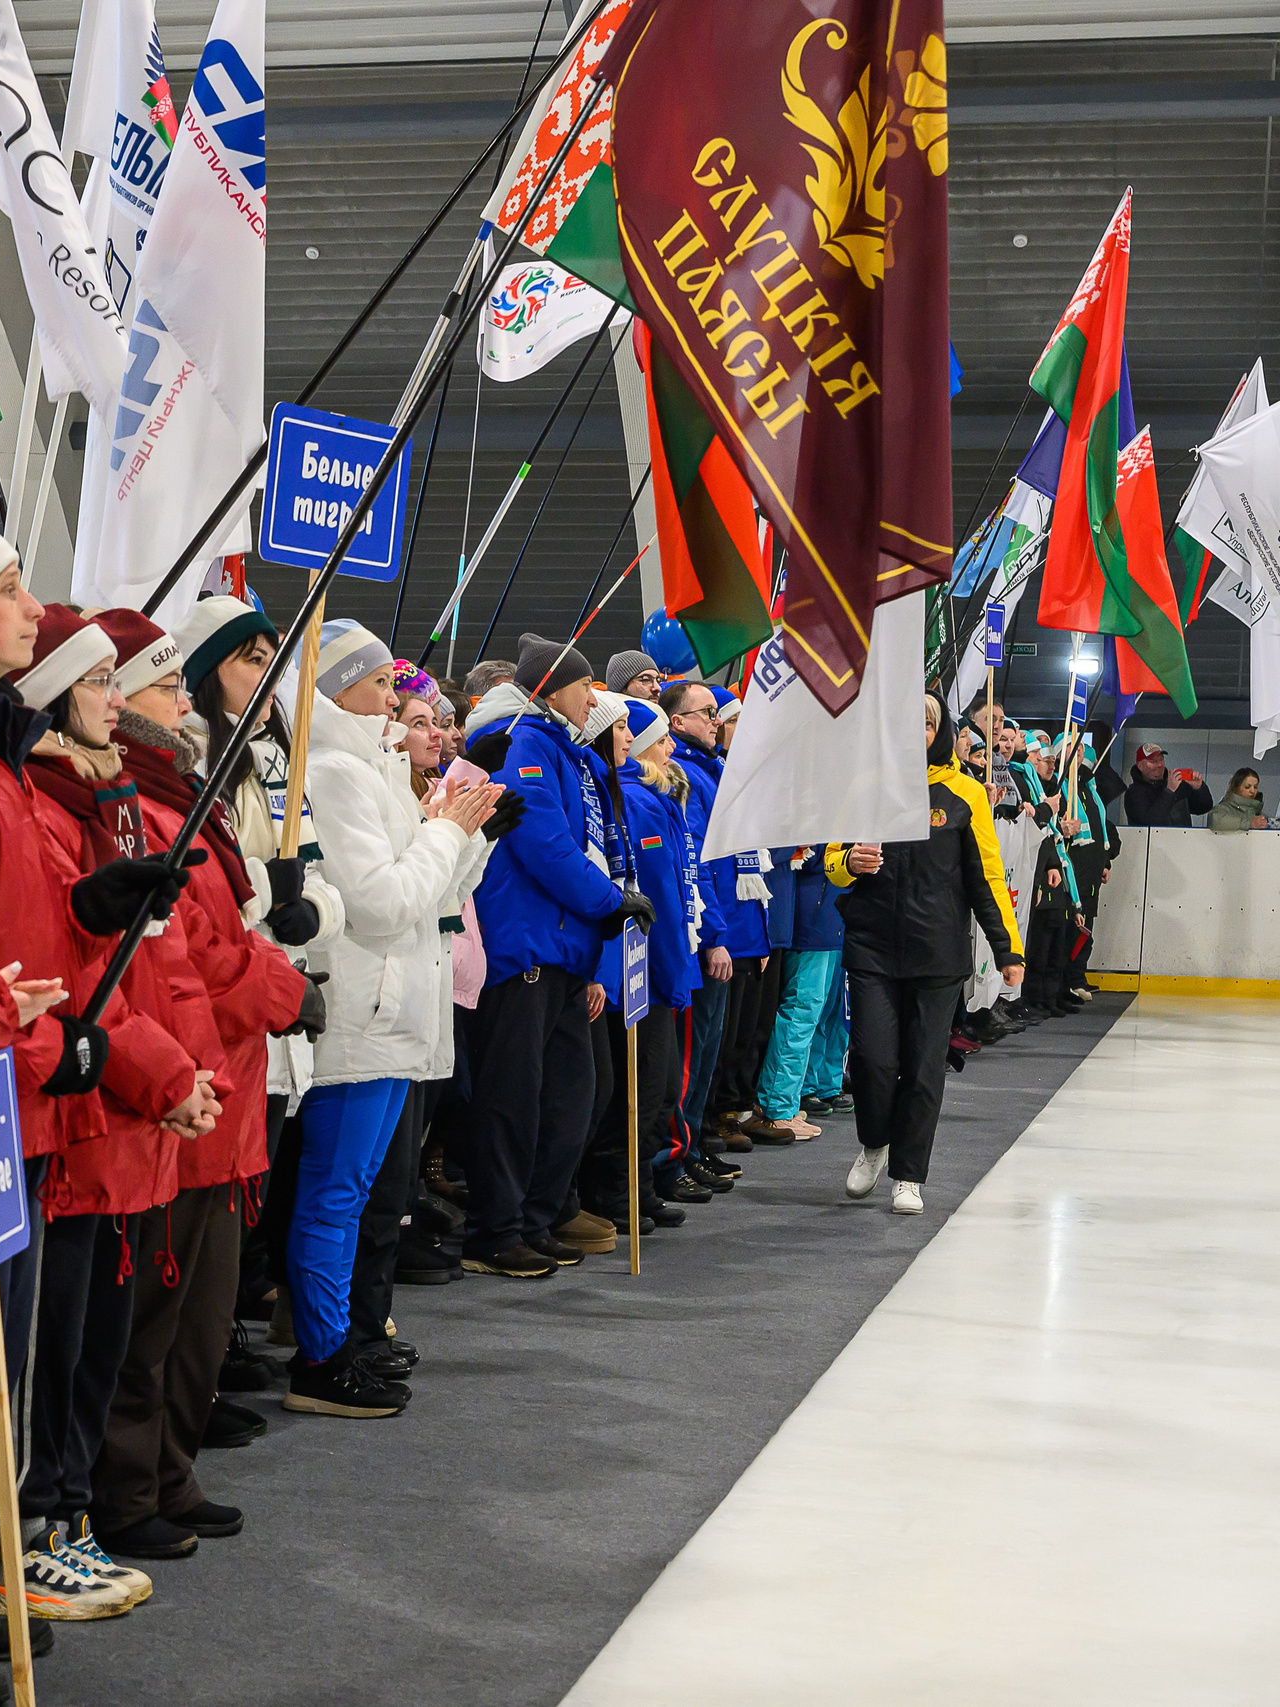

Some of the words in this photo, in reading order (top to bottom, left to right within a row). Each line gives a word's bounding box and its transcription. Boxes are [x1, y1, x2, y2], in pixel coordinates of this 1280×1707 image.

[184, 104, 267, 241] ПУБЛИКАНС
[653, 207, 812, 440] ПАЯСЫ
[301, 441, 377, 490] Белые
[150, 645, 180, 667] БЕЛА
